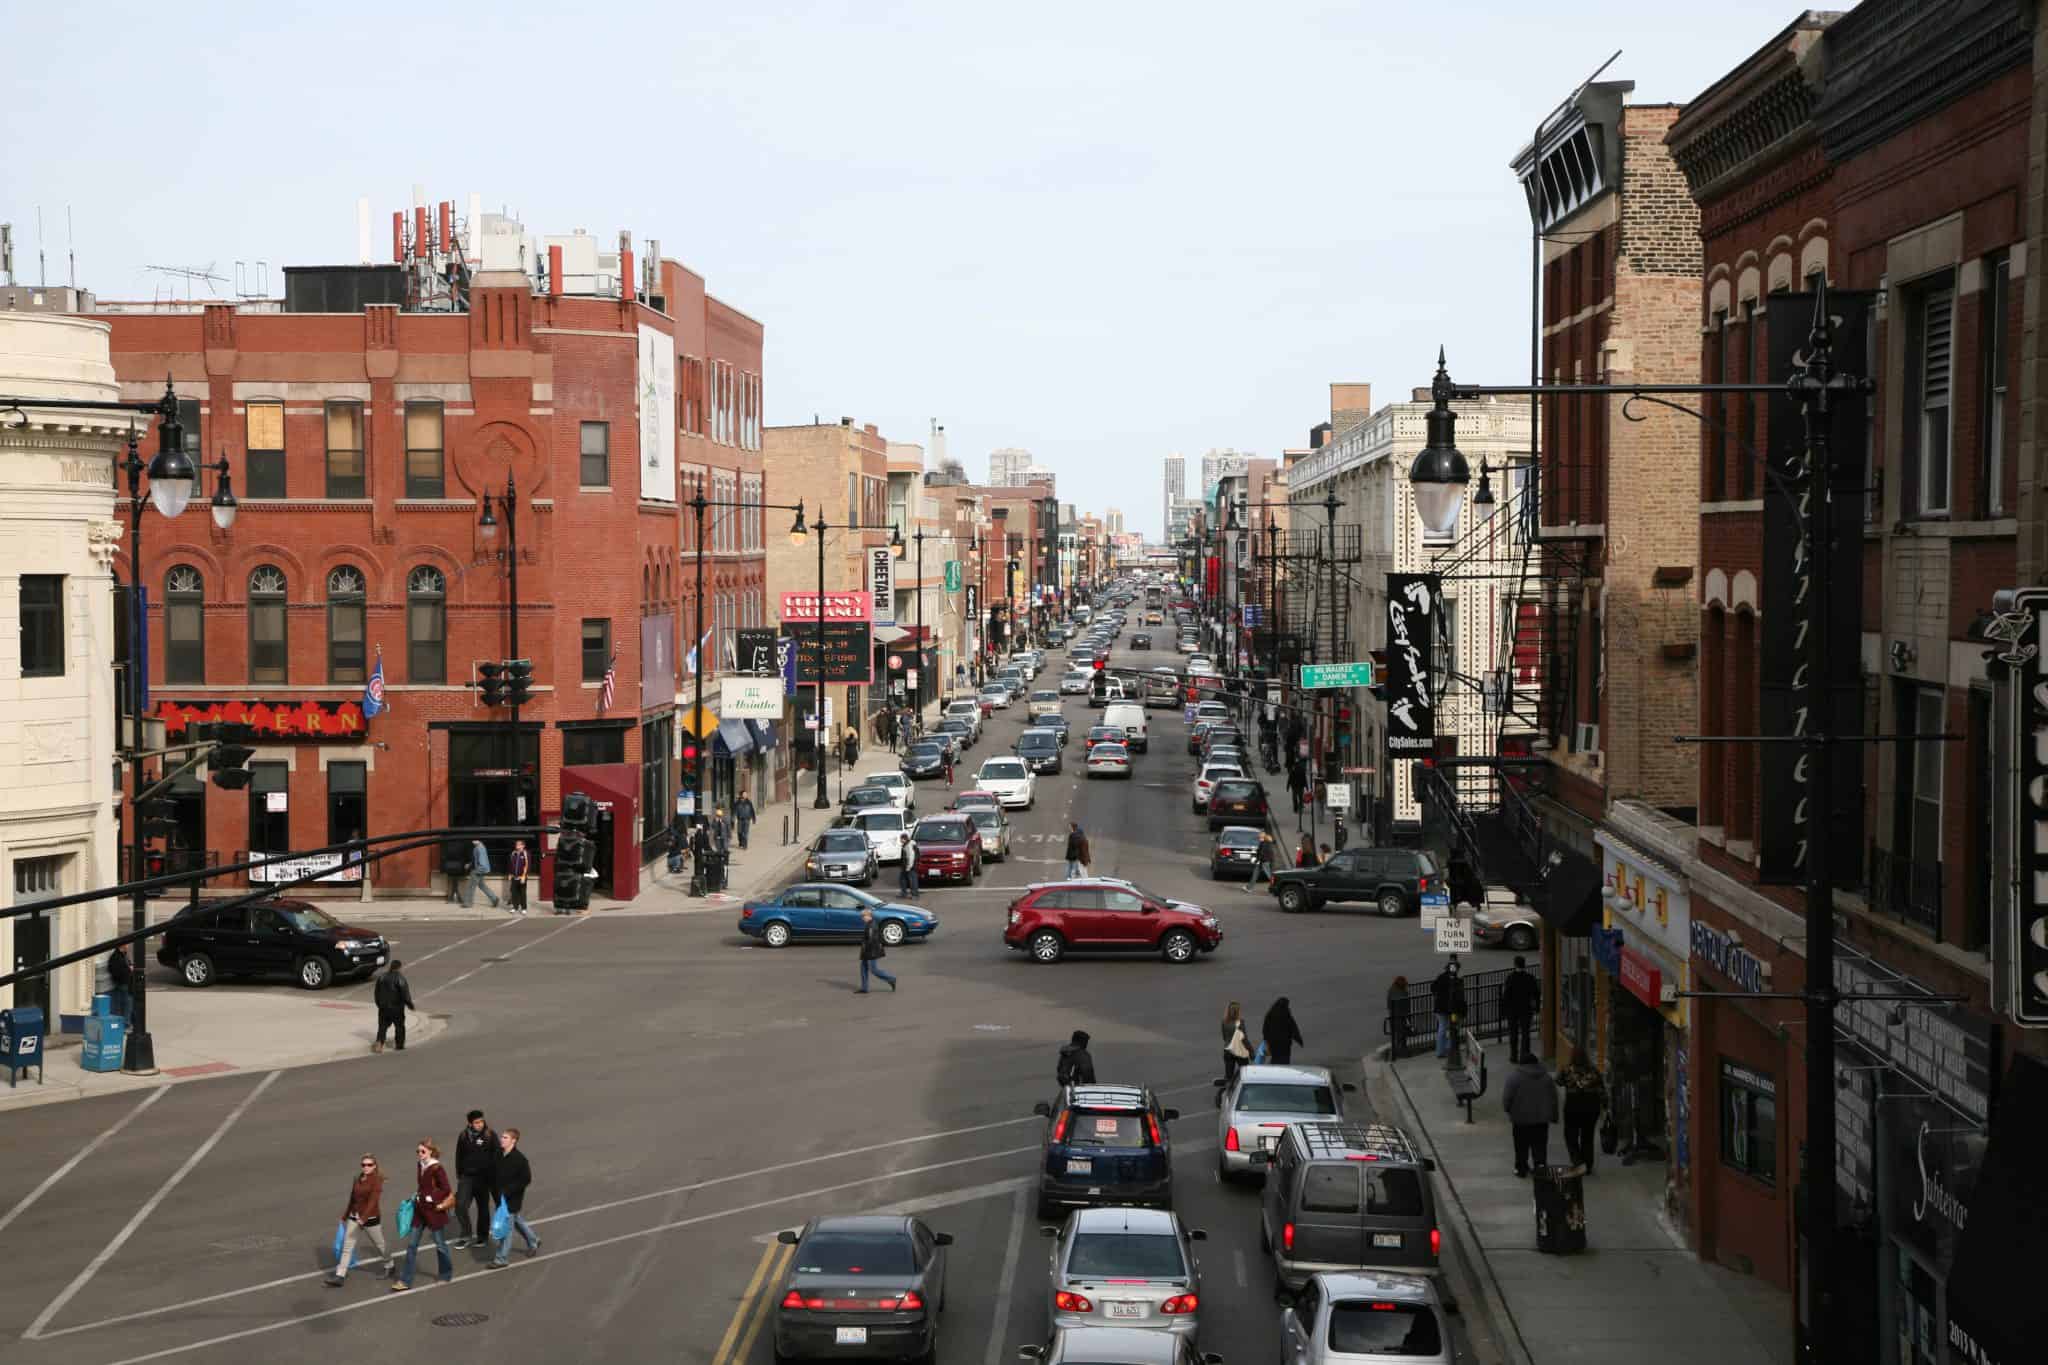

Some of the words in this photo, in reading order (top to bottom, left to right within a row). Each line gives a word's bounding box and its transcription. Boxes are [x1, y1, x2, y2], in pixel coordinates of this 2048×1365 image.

[874, 550, 889, 606] CHEETAH
[184, 713, 359, 730] TAVERN
[1446, 920, 1461, 928] NO
[1949, 1320, 1968, 1355] 2013
